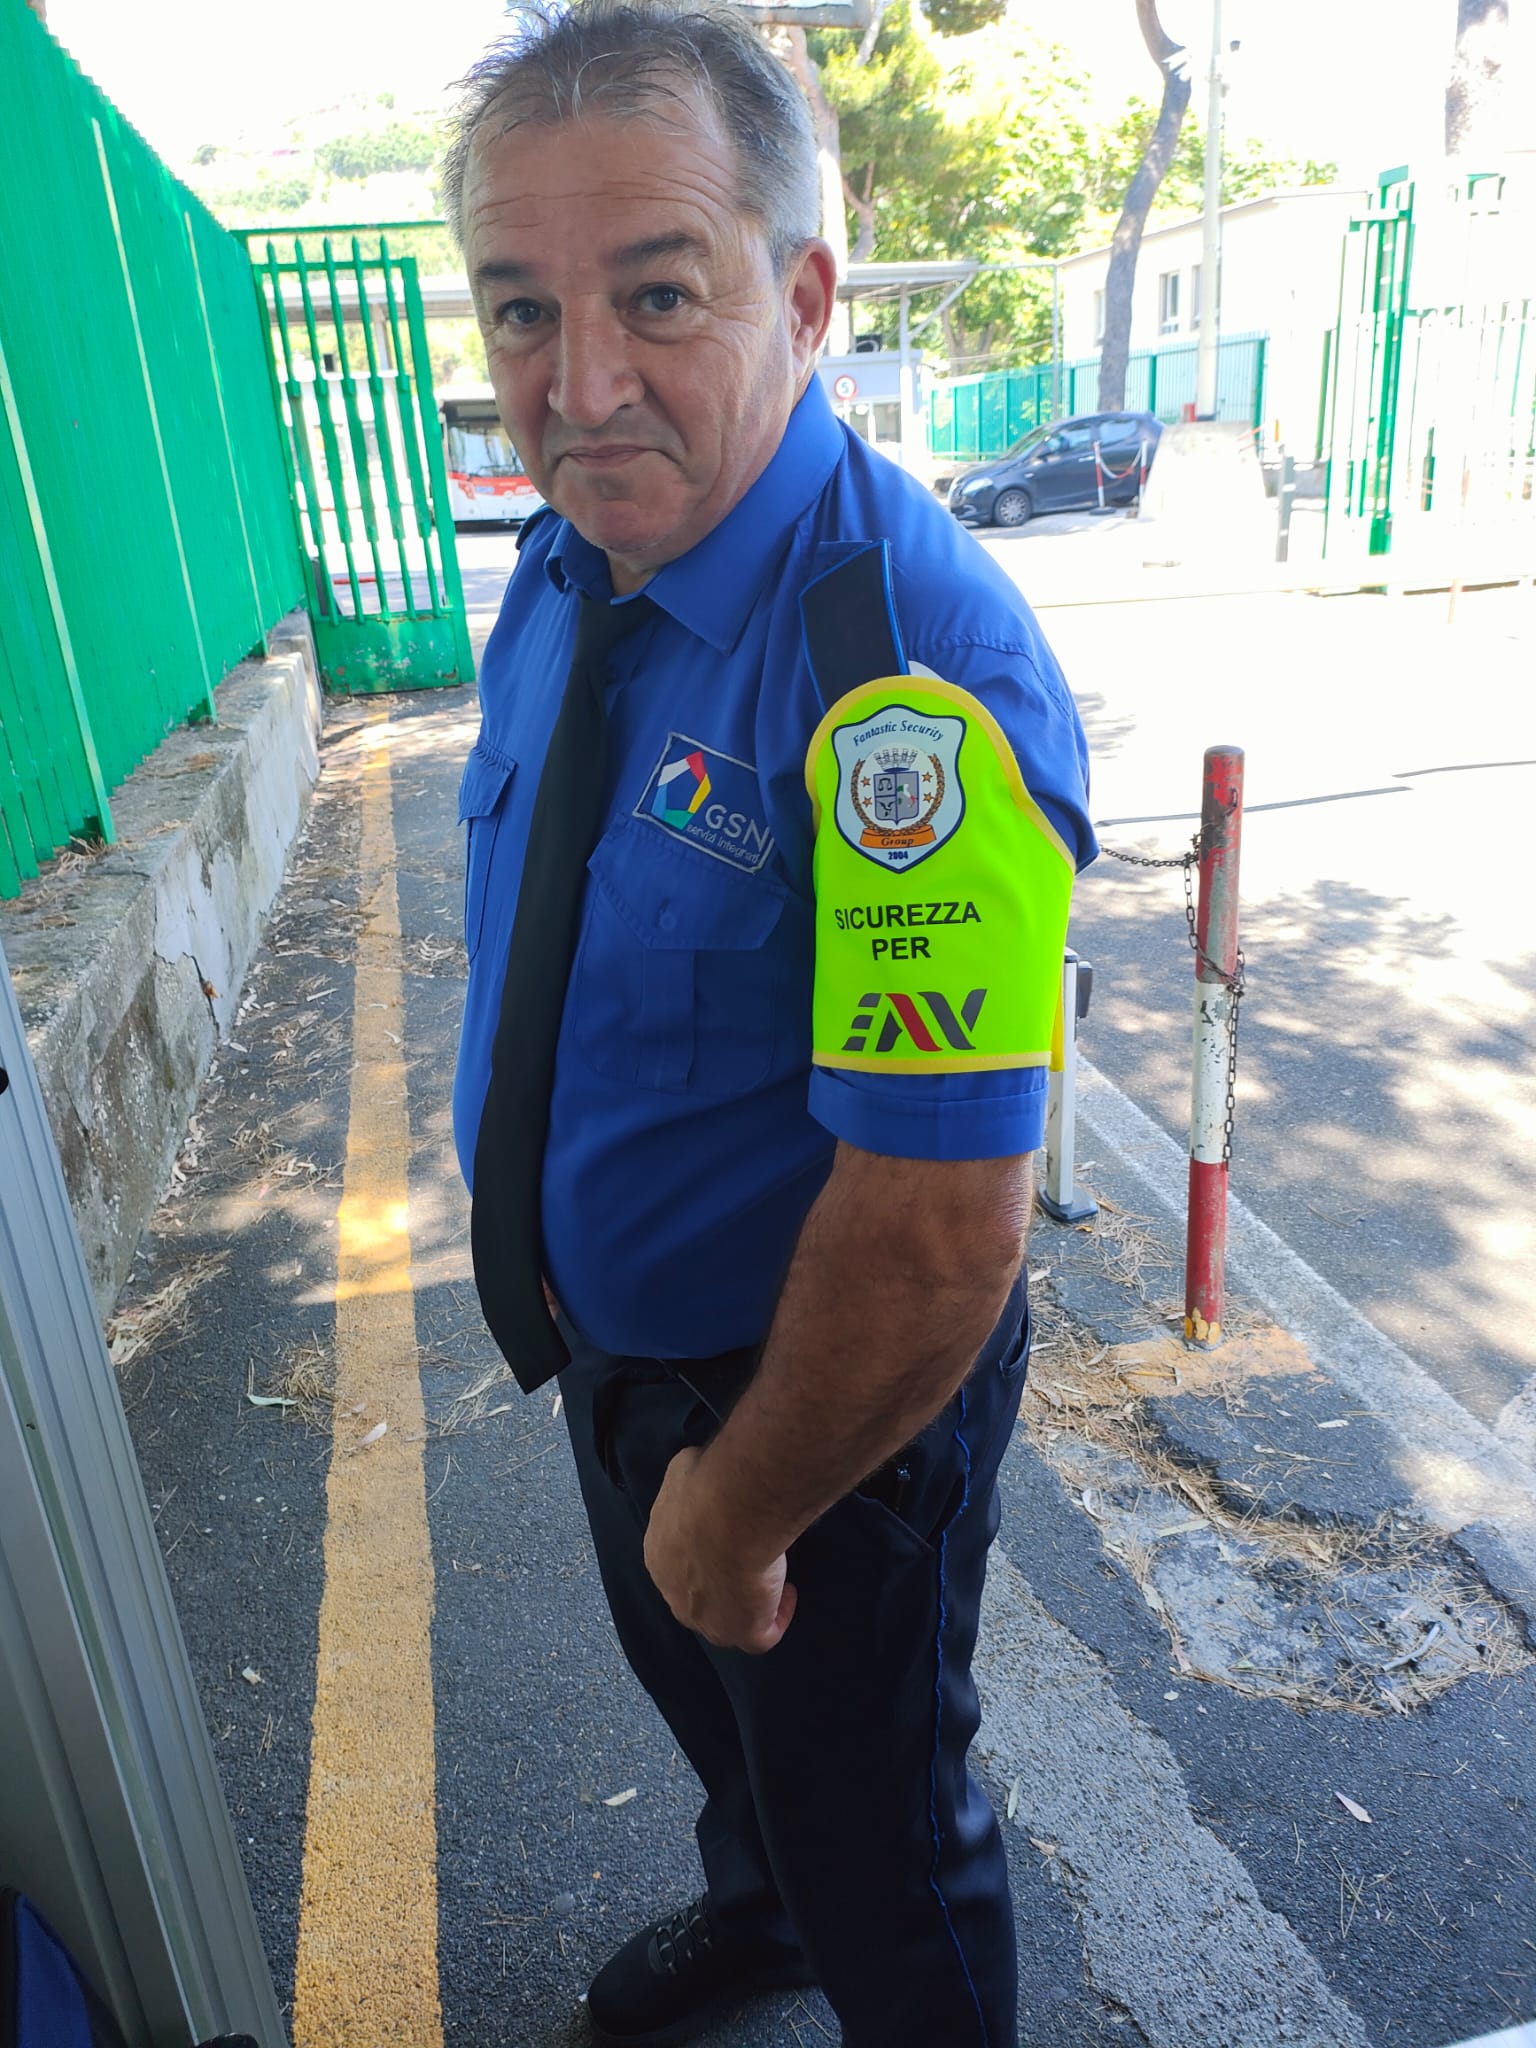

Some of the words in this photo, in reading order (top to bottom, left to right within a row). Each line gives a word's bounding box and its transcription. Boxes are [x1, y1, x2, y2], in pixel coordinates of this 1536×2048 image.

[841, 381, 850, 394] 5
[853, 721, 898, 746] Fantastic
[900, 720, 944, 741] Security
[705, 804, 770, 852] GSN
[881, 837, 914, 848] Group
[834, 901, 982, 930] SICUREZZA
[871, 936, 932, 961] PER
[841, 988, 988, 1052] EAV
